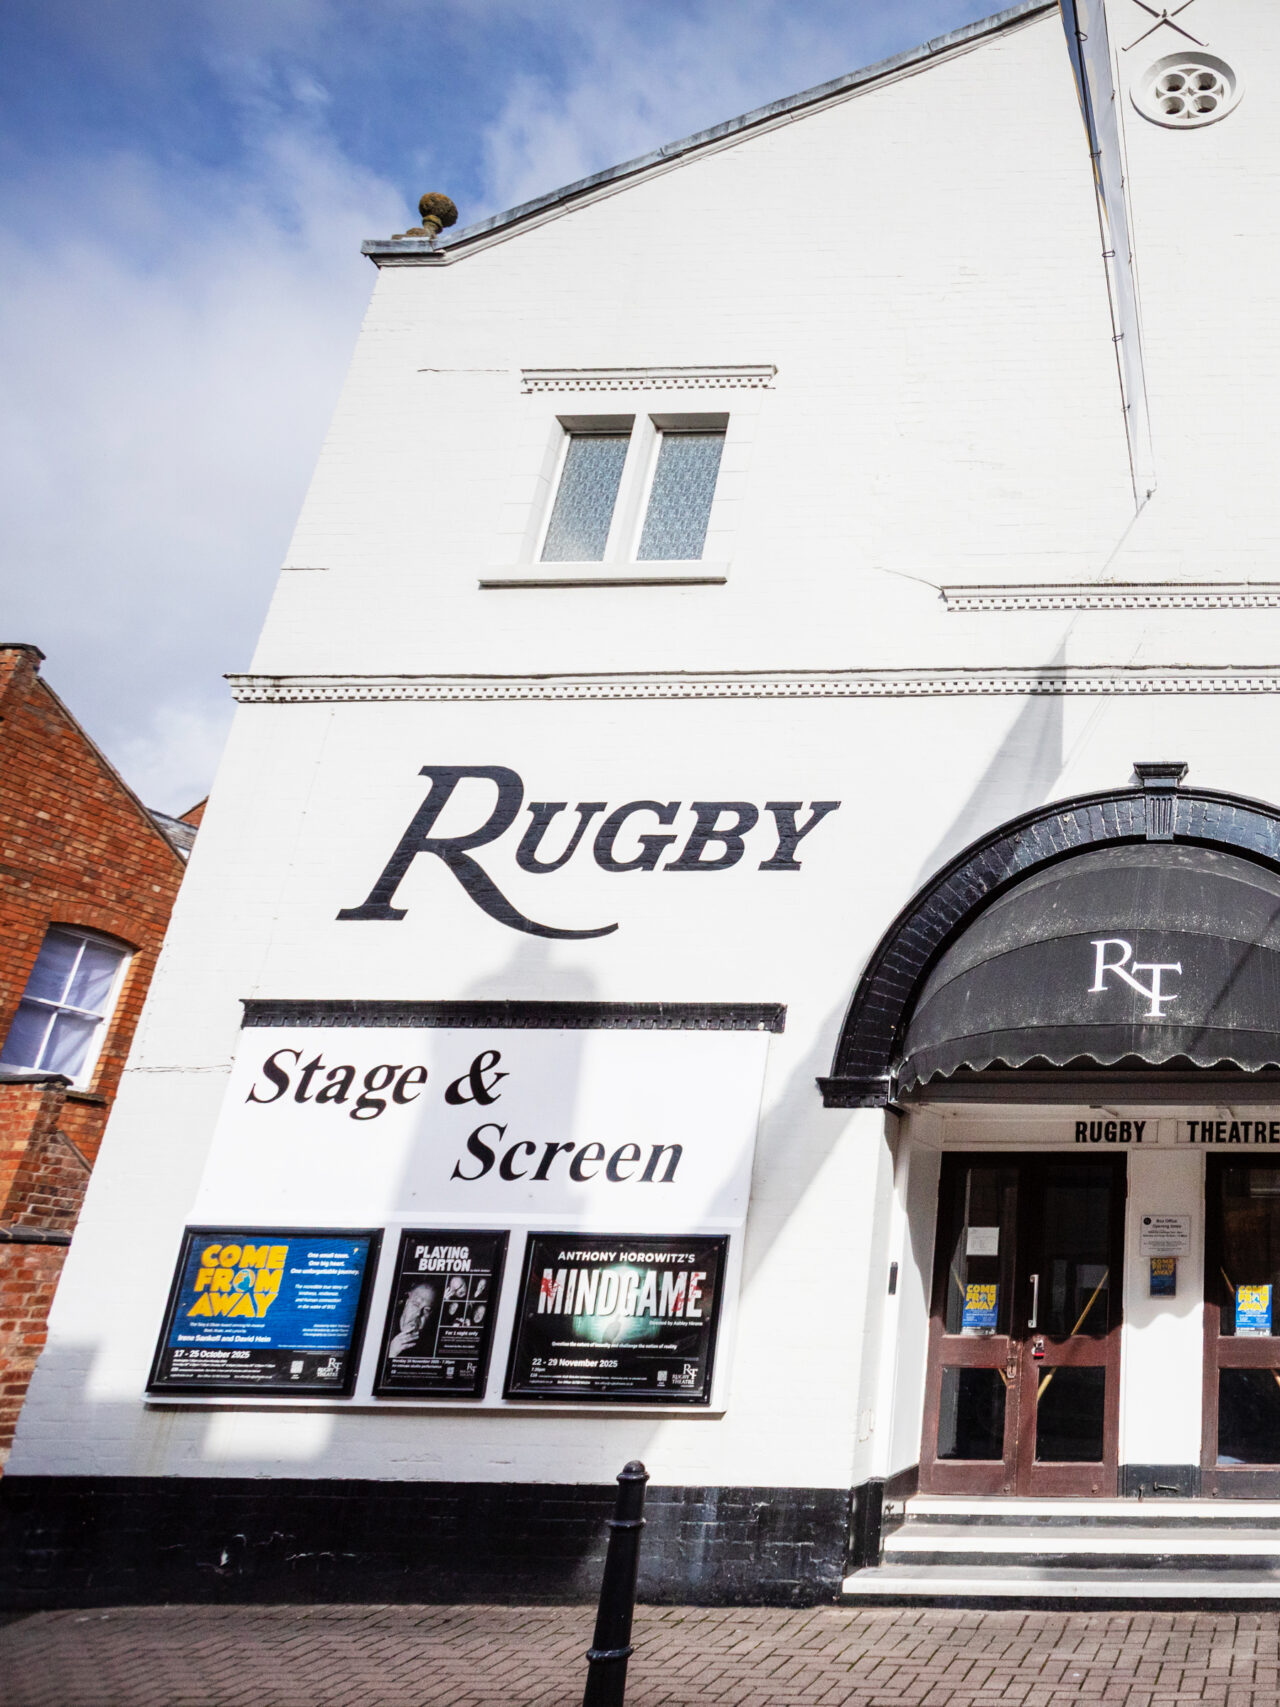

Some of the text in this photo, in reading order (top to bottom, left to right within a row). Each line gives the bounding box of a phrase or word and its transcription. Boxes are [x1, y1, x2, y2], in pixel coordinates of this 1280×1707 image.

[335, 765, 842, 940] RUGBY
[244, 1048, 511, 1121] Stage &
[1075, 1120, 1280, 1143] RUGBY THEATRE
[449, 1122, 684, 1184] Screen
[201, 1244, 289, 1269] COME
[414, 1245, 469, 1260] PLAYING
[557, 1251, 617, 1262] ANTHONY
[418, 1259, 472, 1272] BURTON
[194, 1268, 284, 1293] FROM
[966, 1284, 997, 1293] COME
[537, 1268, 707, 1318] MINDGAME
[186, 1292, 279, 1318] AWAY
[965, 1301, 997, 1310] AWAY
[173, 1349, 185, 1358] 17
[200, 1349, 231, 1358] October
[231, 1350, 251, 1359] 2025
[532, 1358, 542, 1366] 22
[547, 1358, 558, 1366] 29
[559, 1358, 598, 1367] November
[599, 1360, 618, 1368] 2025
